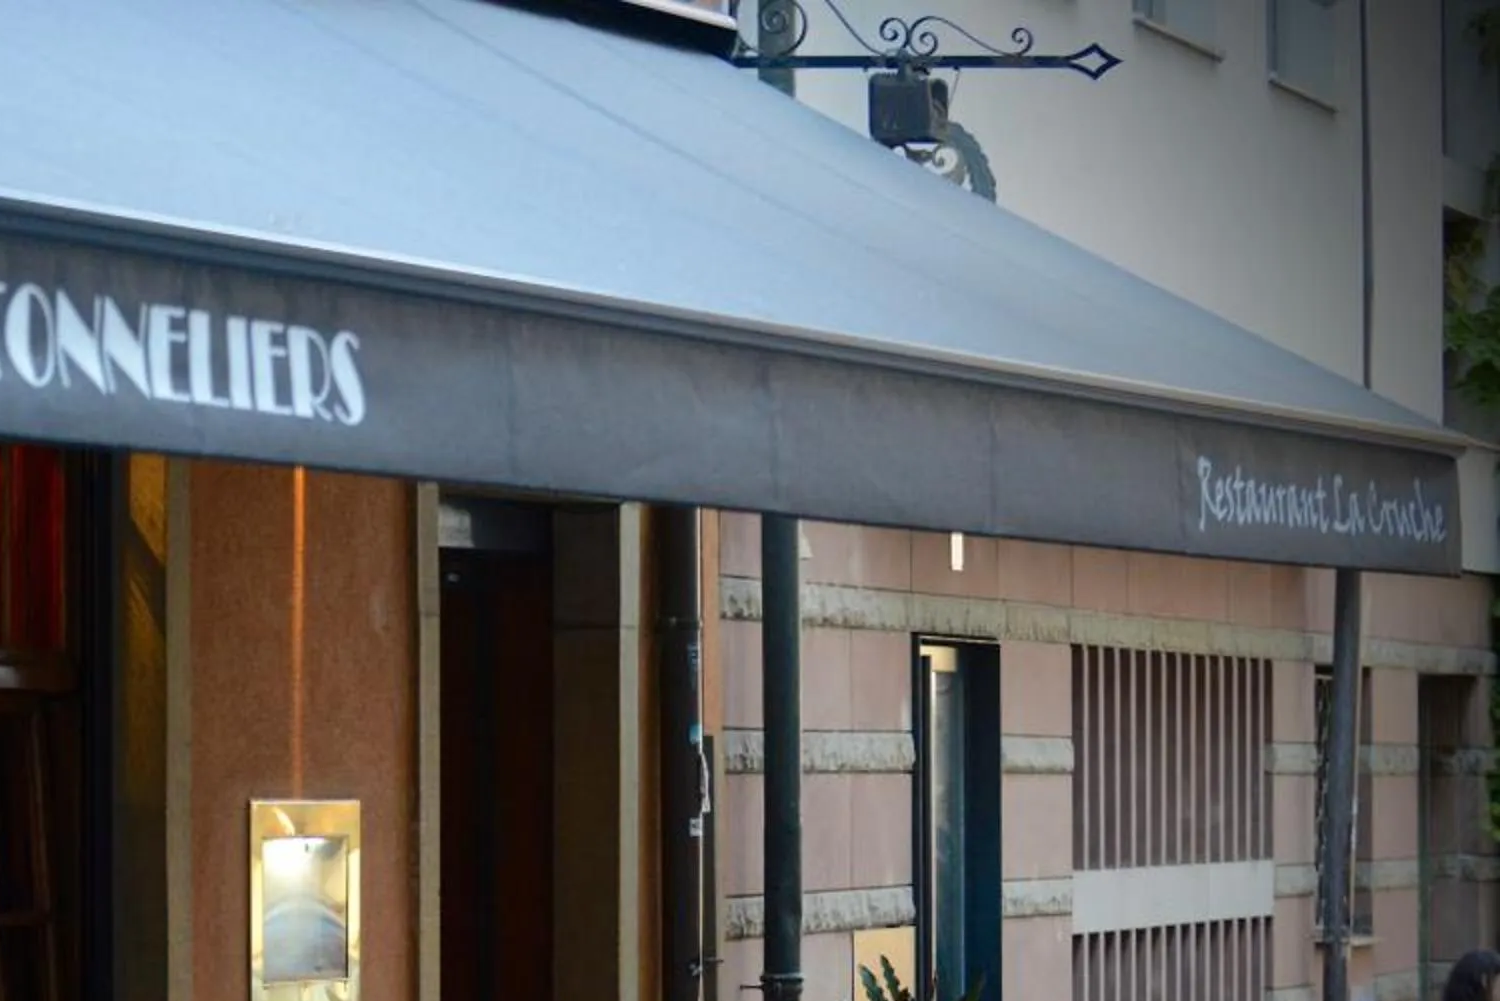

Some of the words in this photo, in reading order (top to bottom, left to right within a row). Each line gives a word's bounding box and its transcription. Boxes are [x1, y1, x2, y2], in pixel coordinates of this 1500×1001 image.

[1197, 455, 1330, 534] Restaurant
[1333, 474, 1366, 536] La
[1368, 476, 1447, 544] Cruche
